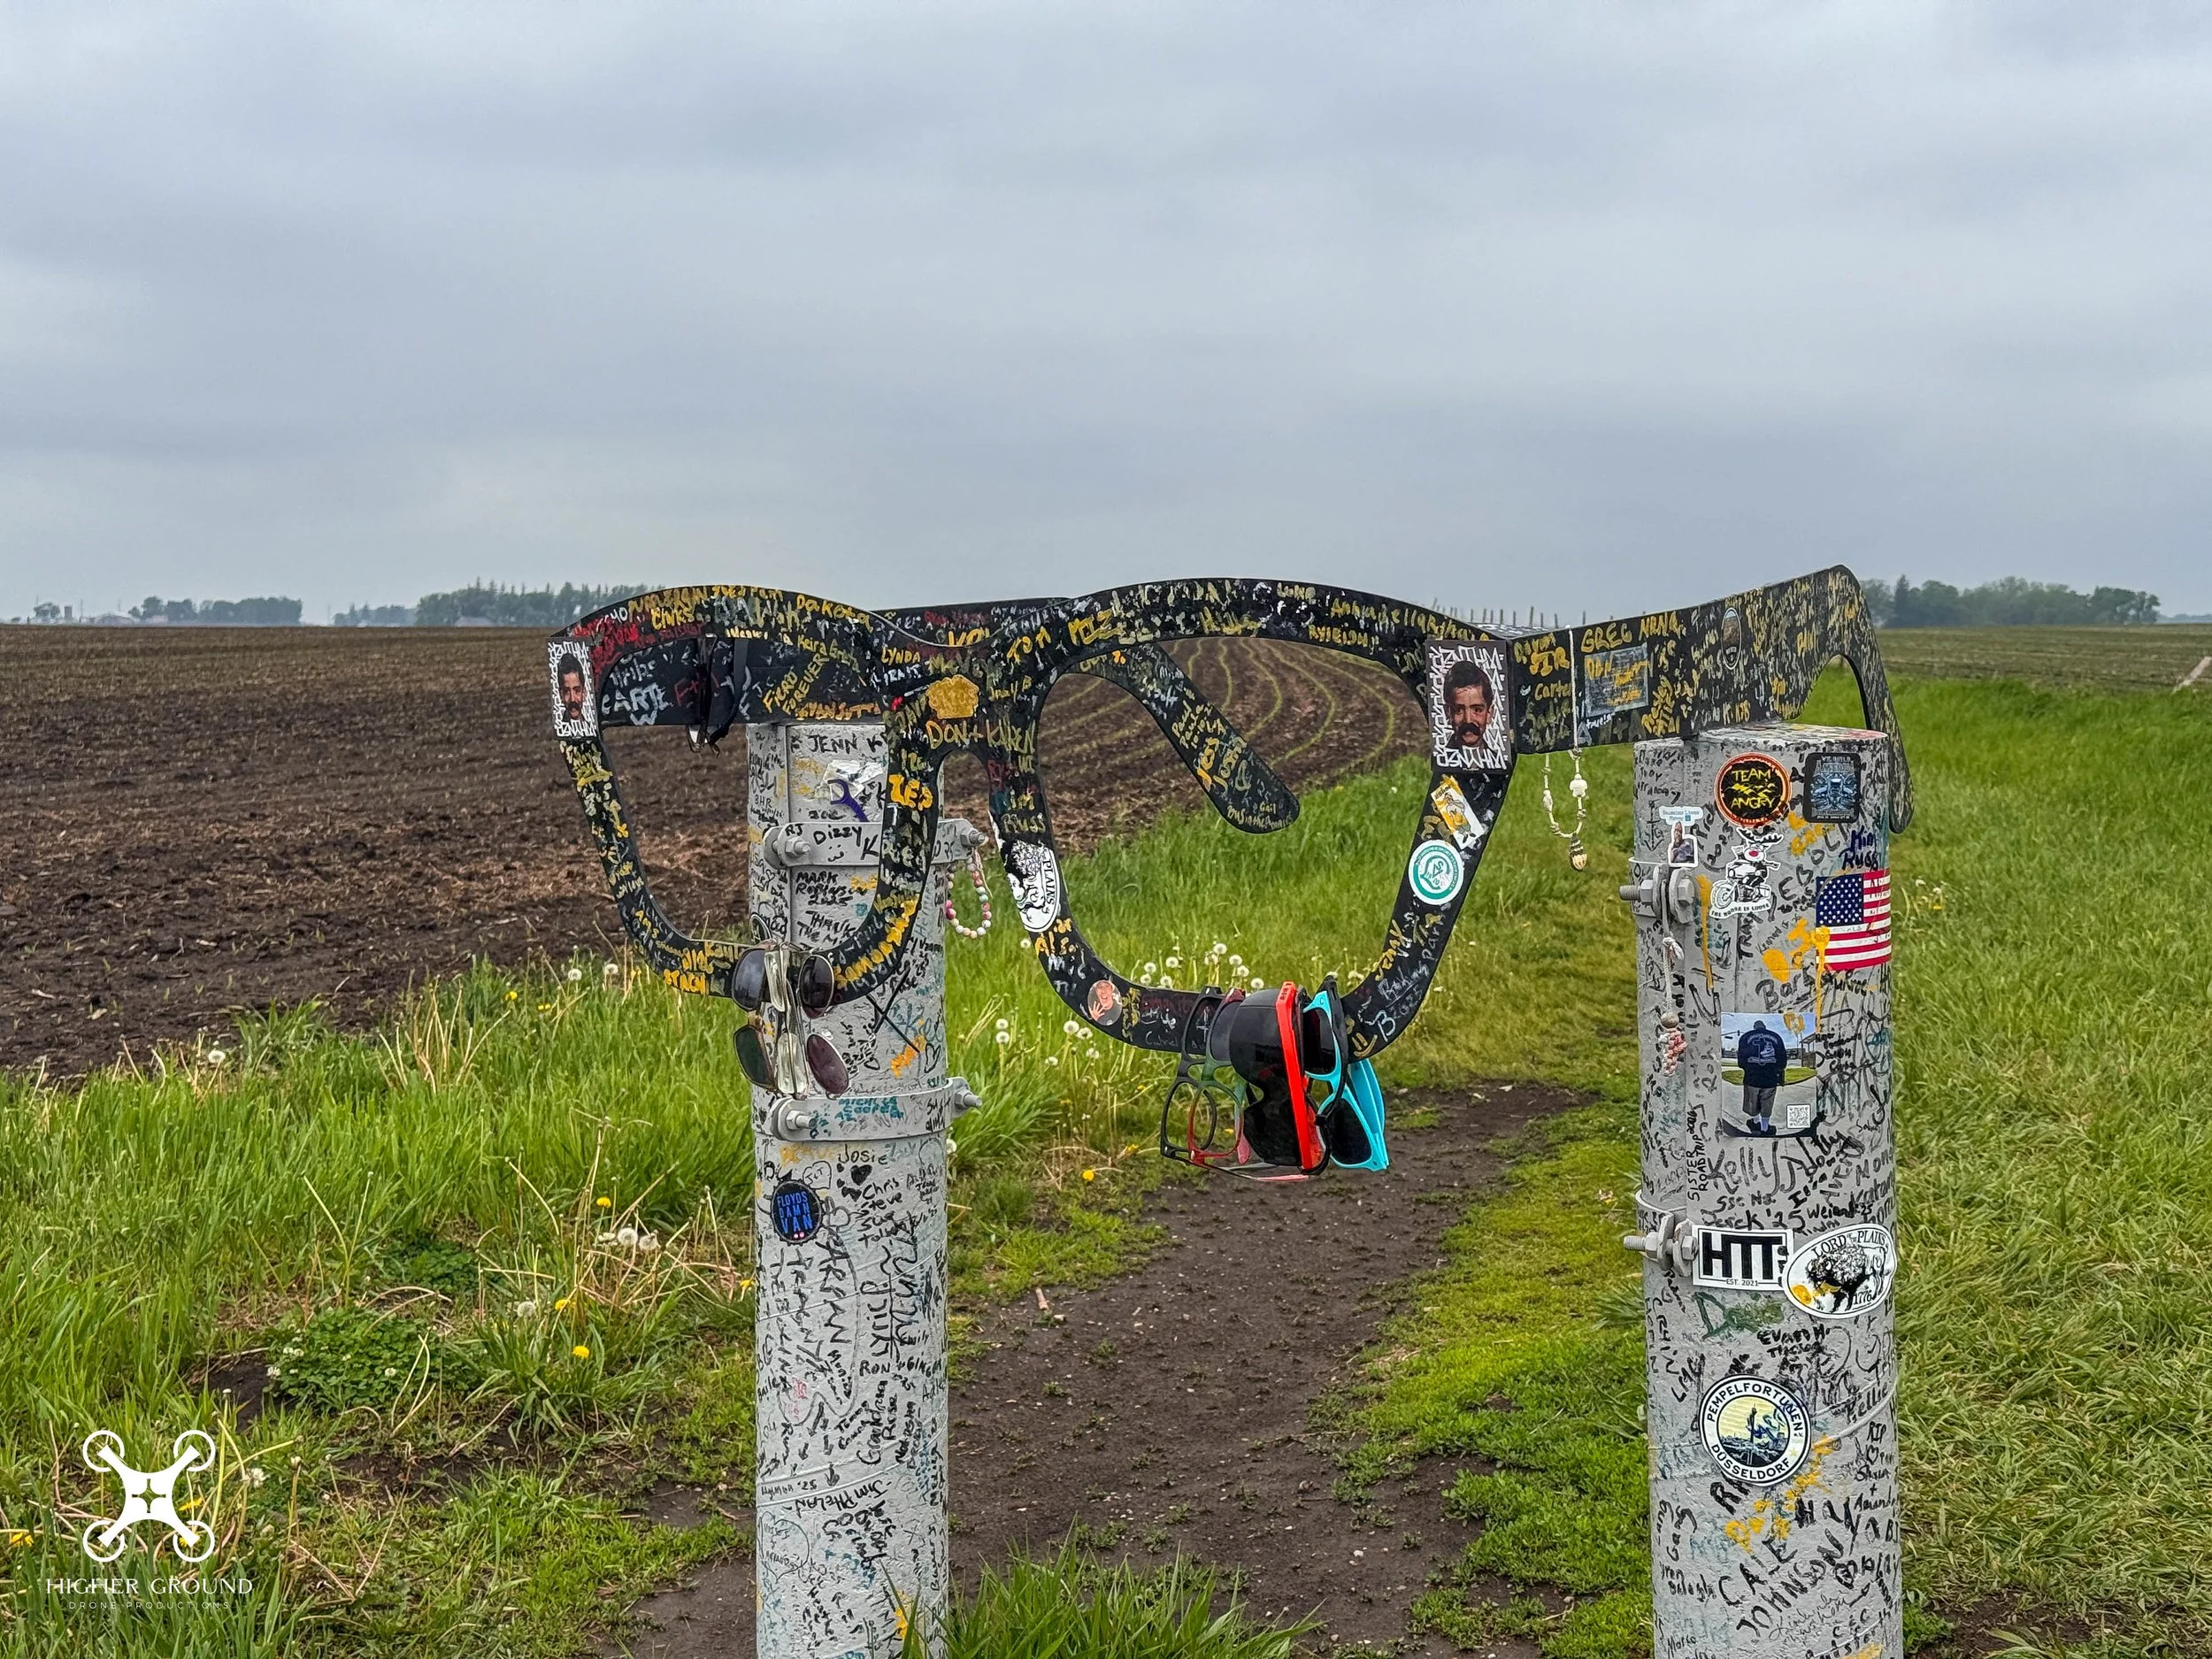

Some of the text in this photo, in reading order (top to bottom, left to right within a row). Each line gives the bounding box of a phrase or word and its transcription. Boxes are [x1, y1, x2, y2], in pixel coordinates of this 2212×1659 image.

[797, 594, 873, 634] Dakota
[808, 733, 858, 754] JENN
[926, 720, 968, 749] DON
[1732, 768, 1771, 782] TEAM
[1731, 797, 1775, 809] ANGRY
[785, 823, 804, 837] RJ
[813, 825, 863, 847] Dizzy
[796, 871, 839, 886] MARK
[1042, 860, 1056, 905] PLAINS
[837, 1143, 888, 1164] Josie
[1686, 1150, 1700, 1202] SISTER
[777, 1191, 808, 1207] FLOYDS
[862, 1177, 900, 1200] Chris
[779, 1202, 811, 1219] DAMN
[782, 1216, 813, 1233] VAN
[1811, 1234, 1847, 1257] LORD
[1857, 1230, 1887, 1246] PLAINS
[1854, 1289, 1872, 1305] 1776
[859, 1359, 891, 1377] RON
[1707, 1382, 1803, 1432] PEMPELFORTUNEN
[1867, 1420, 1887, 1444] RIP
[1711, 1443, 1790, 1480] DÜSSELDORF
